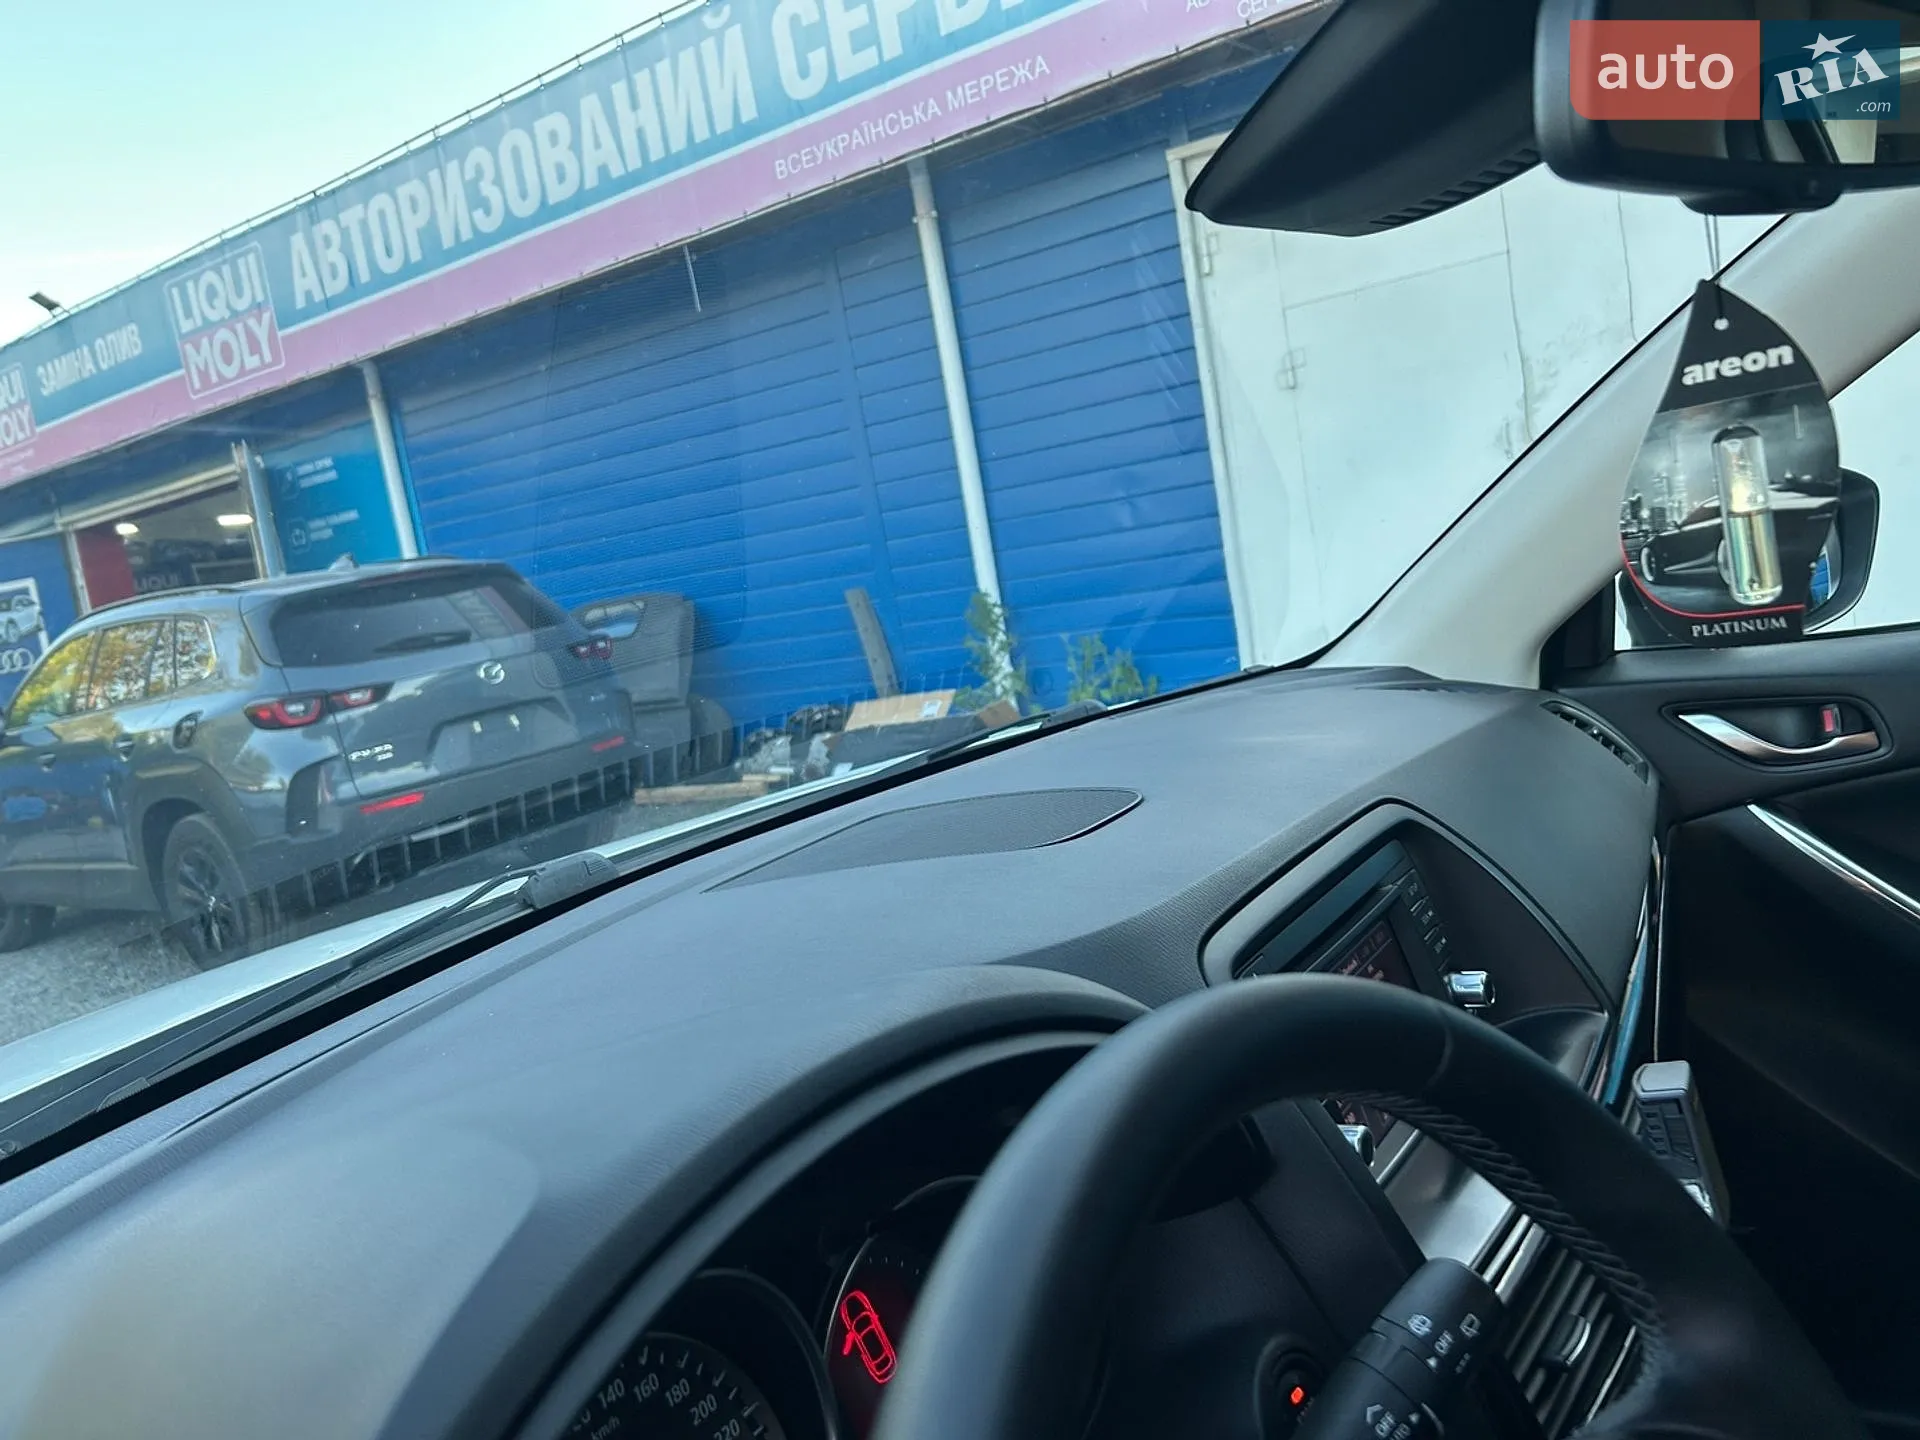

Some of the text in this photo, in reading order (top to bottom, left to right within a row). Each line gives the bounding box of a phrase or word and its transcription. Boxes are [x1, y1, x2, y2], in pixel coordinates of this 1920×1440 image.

[773, 55, 1051, 180] ВСЕУКРАЇНСЬКА МЕРЕЖА
[290, 3, 759, 309] АВТОРИЗОВАНИЙ
[171, 252, 265, 333] LIQUI
[36, 322, 142, 396] ЗАМІНА ОЛИВ
[184, 311, 273, 390] MOLY
[1681, 344, 1795, 386] areon
[0, 404, 32, 449] OLY
[1691, 616, 1788, 638] PLATINUM
[598, 1378, 625, 1409] 140
[633, 1372, 660, 1403] 160
[665, 1377, 691, 1407] 180
[689, 1393, 718, 1426] 200
